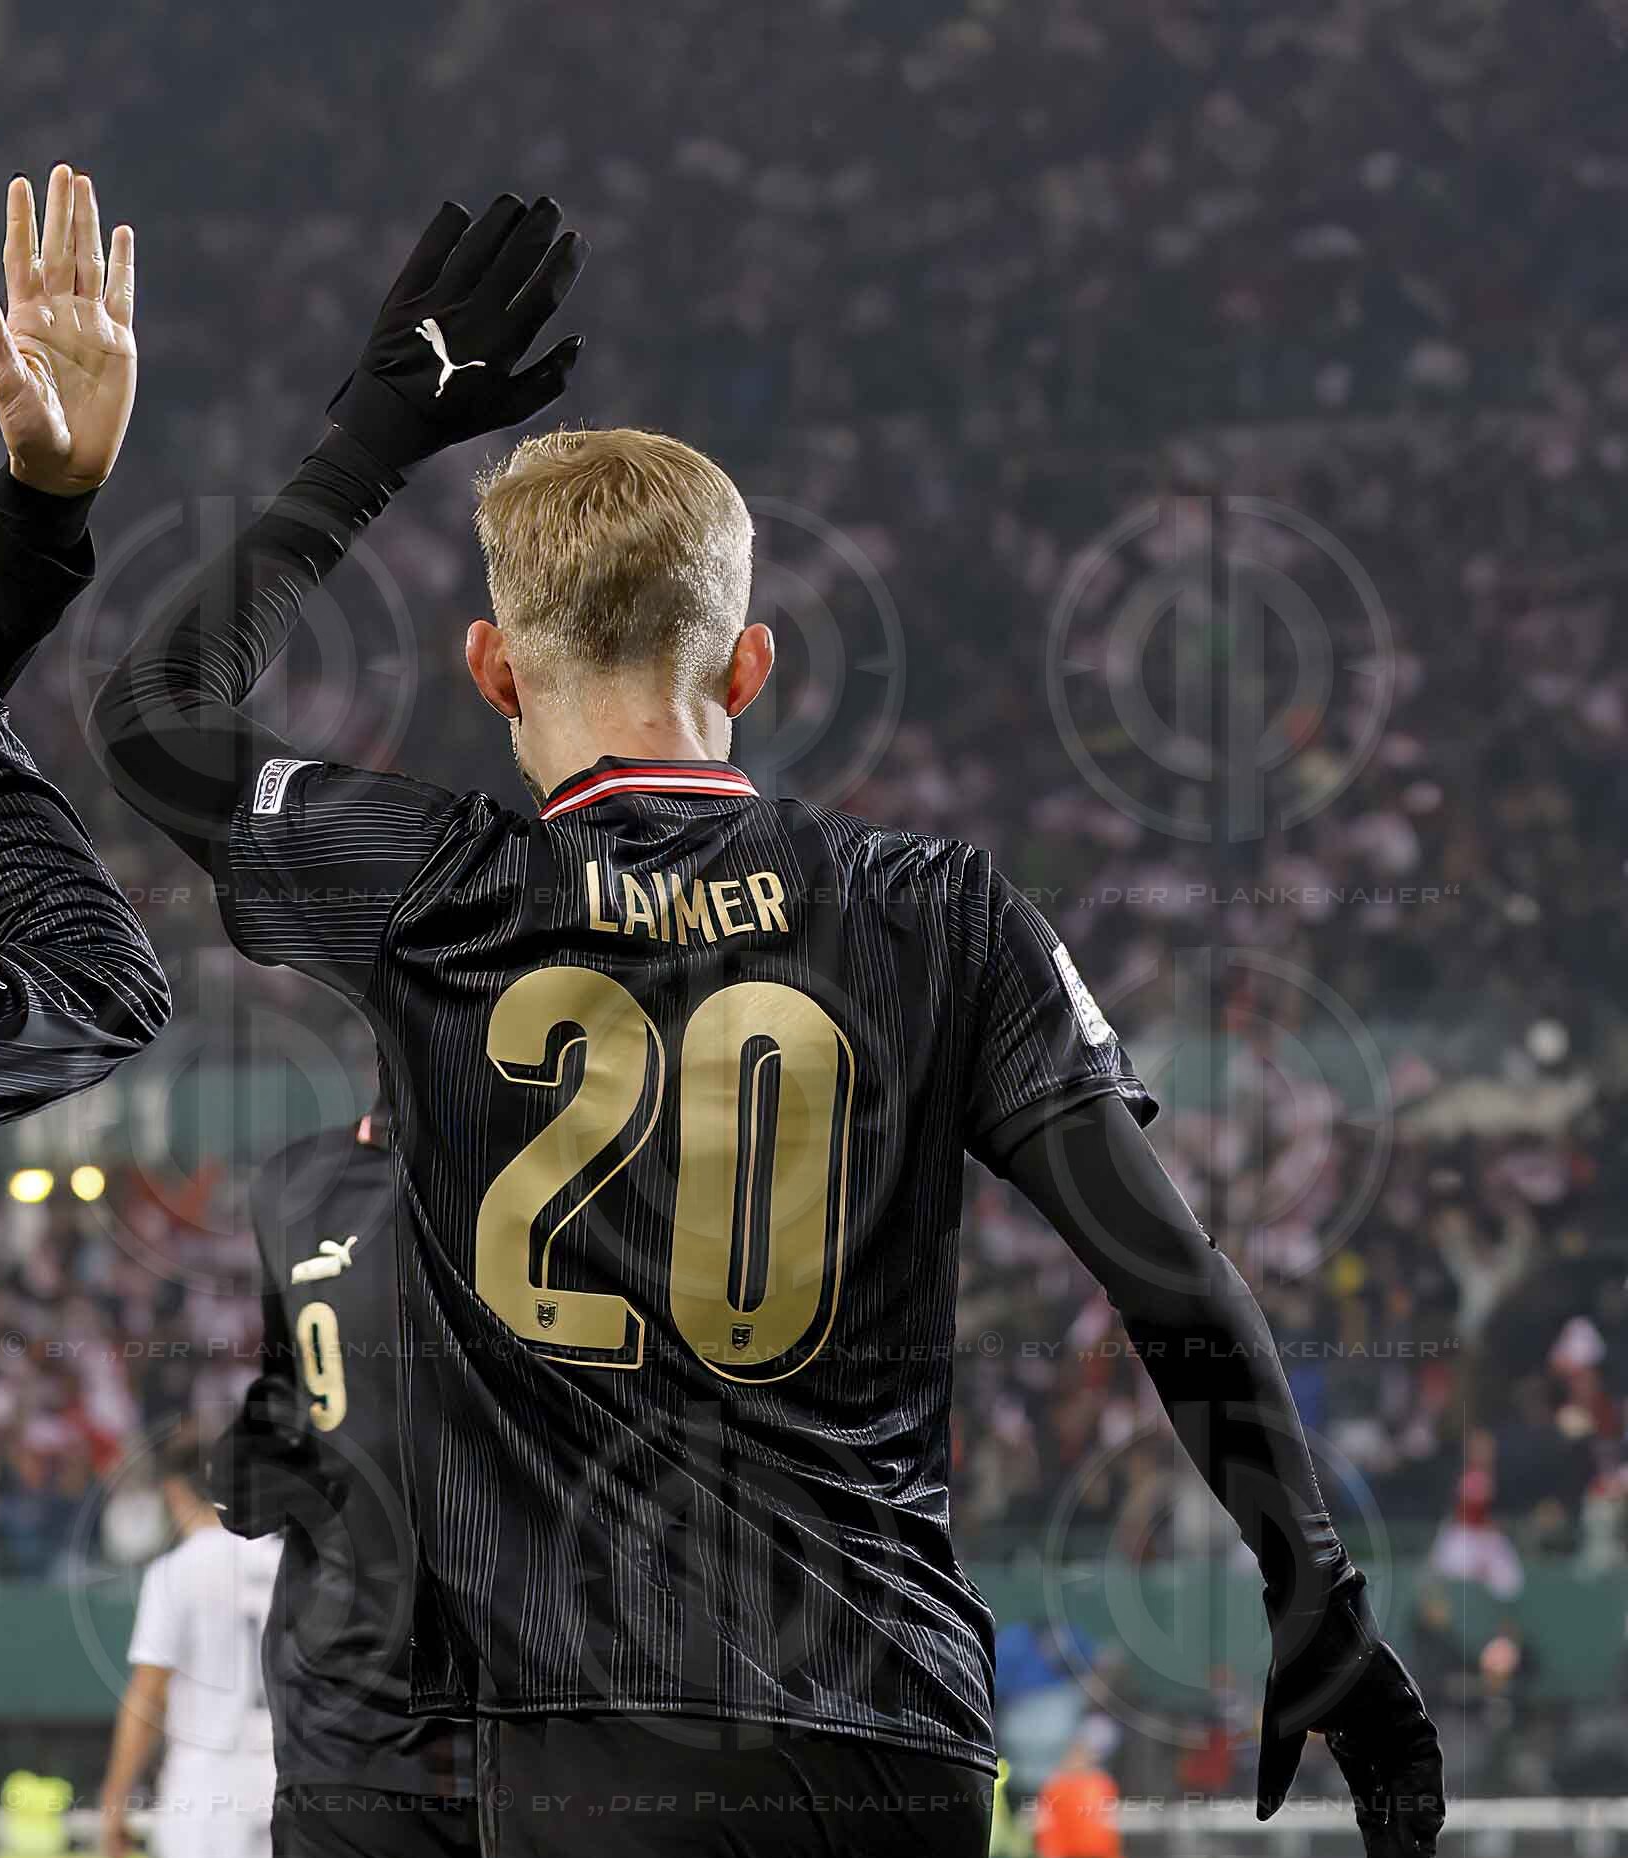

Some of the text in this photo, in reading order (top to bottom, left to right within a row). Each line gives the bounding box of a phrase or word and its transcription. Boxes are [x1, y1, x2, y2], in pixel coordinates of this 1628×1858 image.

[585, 860, 790, 946] LAIMER
[475, 965, 855, 1385] 20
[296, 1301, 348, 1432] 9
